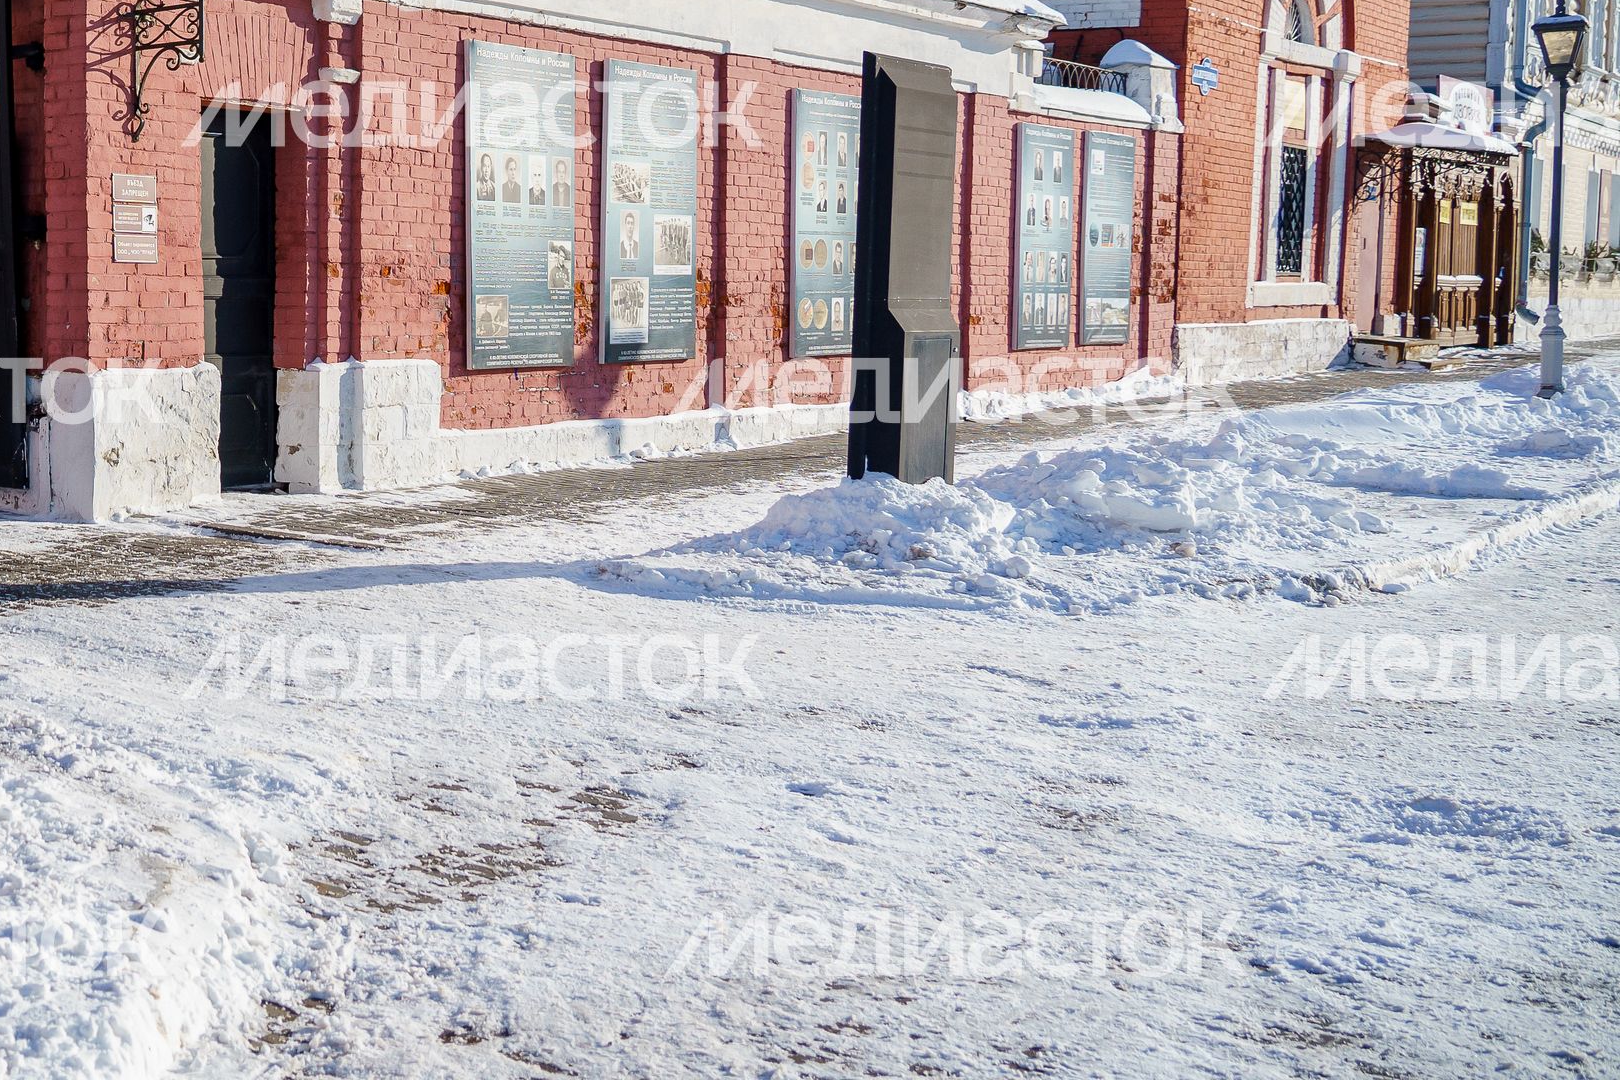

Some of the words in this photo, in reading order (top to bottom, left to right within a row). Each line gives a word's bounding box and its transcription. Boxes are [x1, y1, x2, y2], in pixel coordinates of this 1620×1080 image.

[476, 47, 508, 60] Надежды
[510, 52, 540, 64] Коломны
[548, 56, 570, 68] России
[614, 65, 641, 77] Надежды
[642, 68, 668, 80] Коломны
[674, 73, 692, 84] России
[122, 189, 148, 198] ЗАПРЕЩЕН
